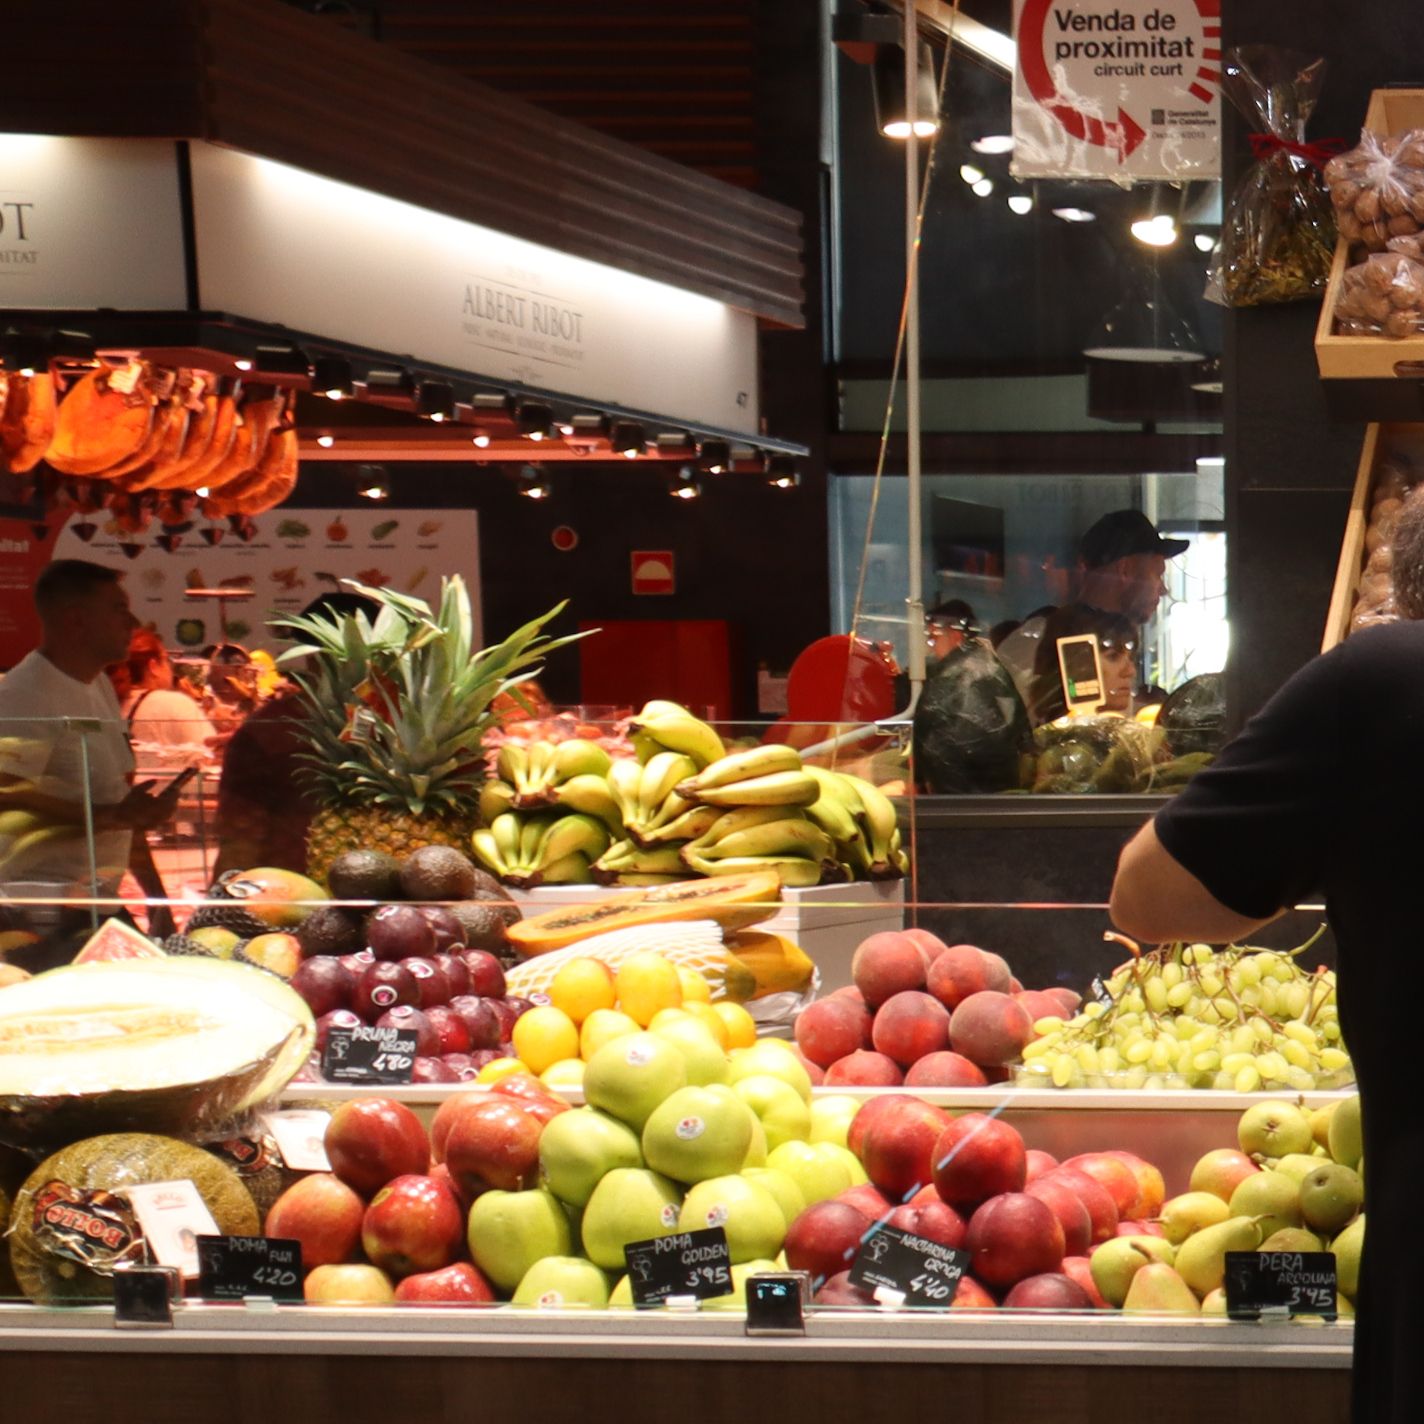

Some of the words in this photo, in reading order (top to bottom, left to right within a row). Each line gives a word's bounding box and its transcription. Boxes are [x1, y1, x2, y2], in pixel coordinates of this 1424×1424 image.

[1055, 10, 1135, 31] Venda
[1143, 10, 1176, 31] de
[1055, 36, 1194, 60] proximitat
[1094, 63, 1145, 76] circuit
[1150, 63, 1183, 76] curt
[463, 284, 526, 328] ALBERT
[532, 301, 583, 343] RIBOT
[352, 1027, 398, 1042] PRUNA
[229, 1237, 268, 1253] POMA
[654, 1233, 693, 1255] POMA
[681, 1244, 728, 1265] GOLDEN
[1260, 1252, 1303, 1272] PERA
[685, 1266, 729, 1287] 3'95
